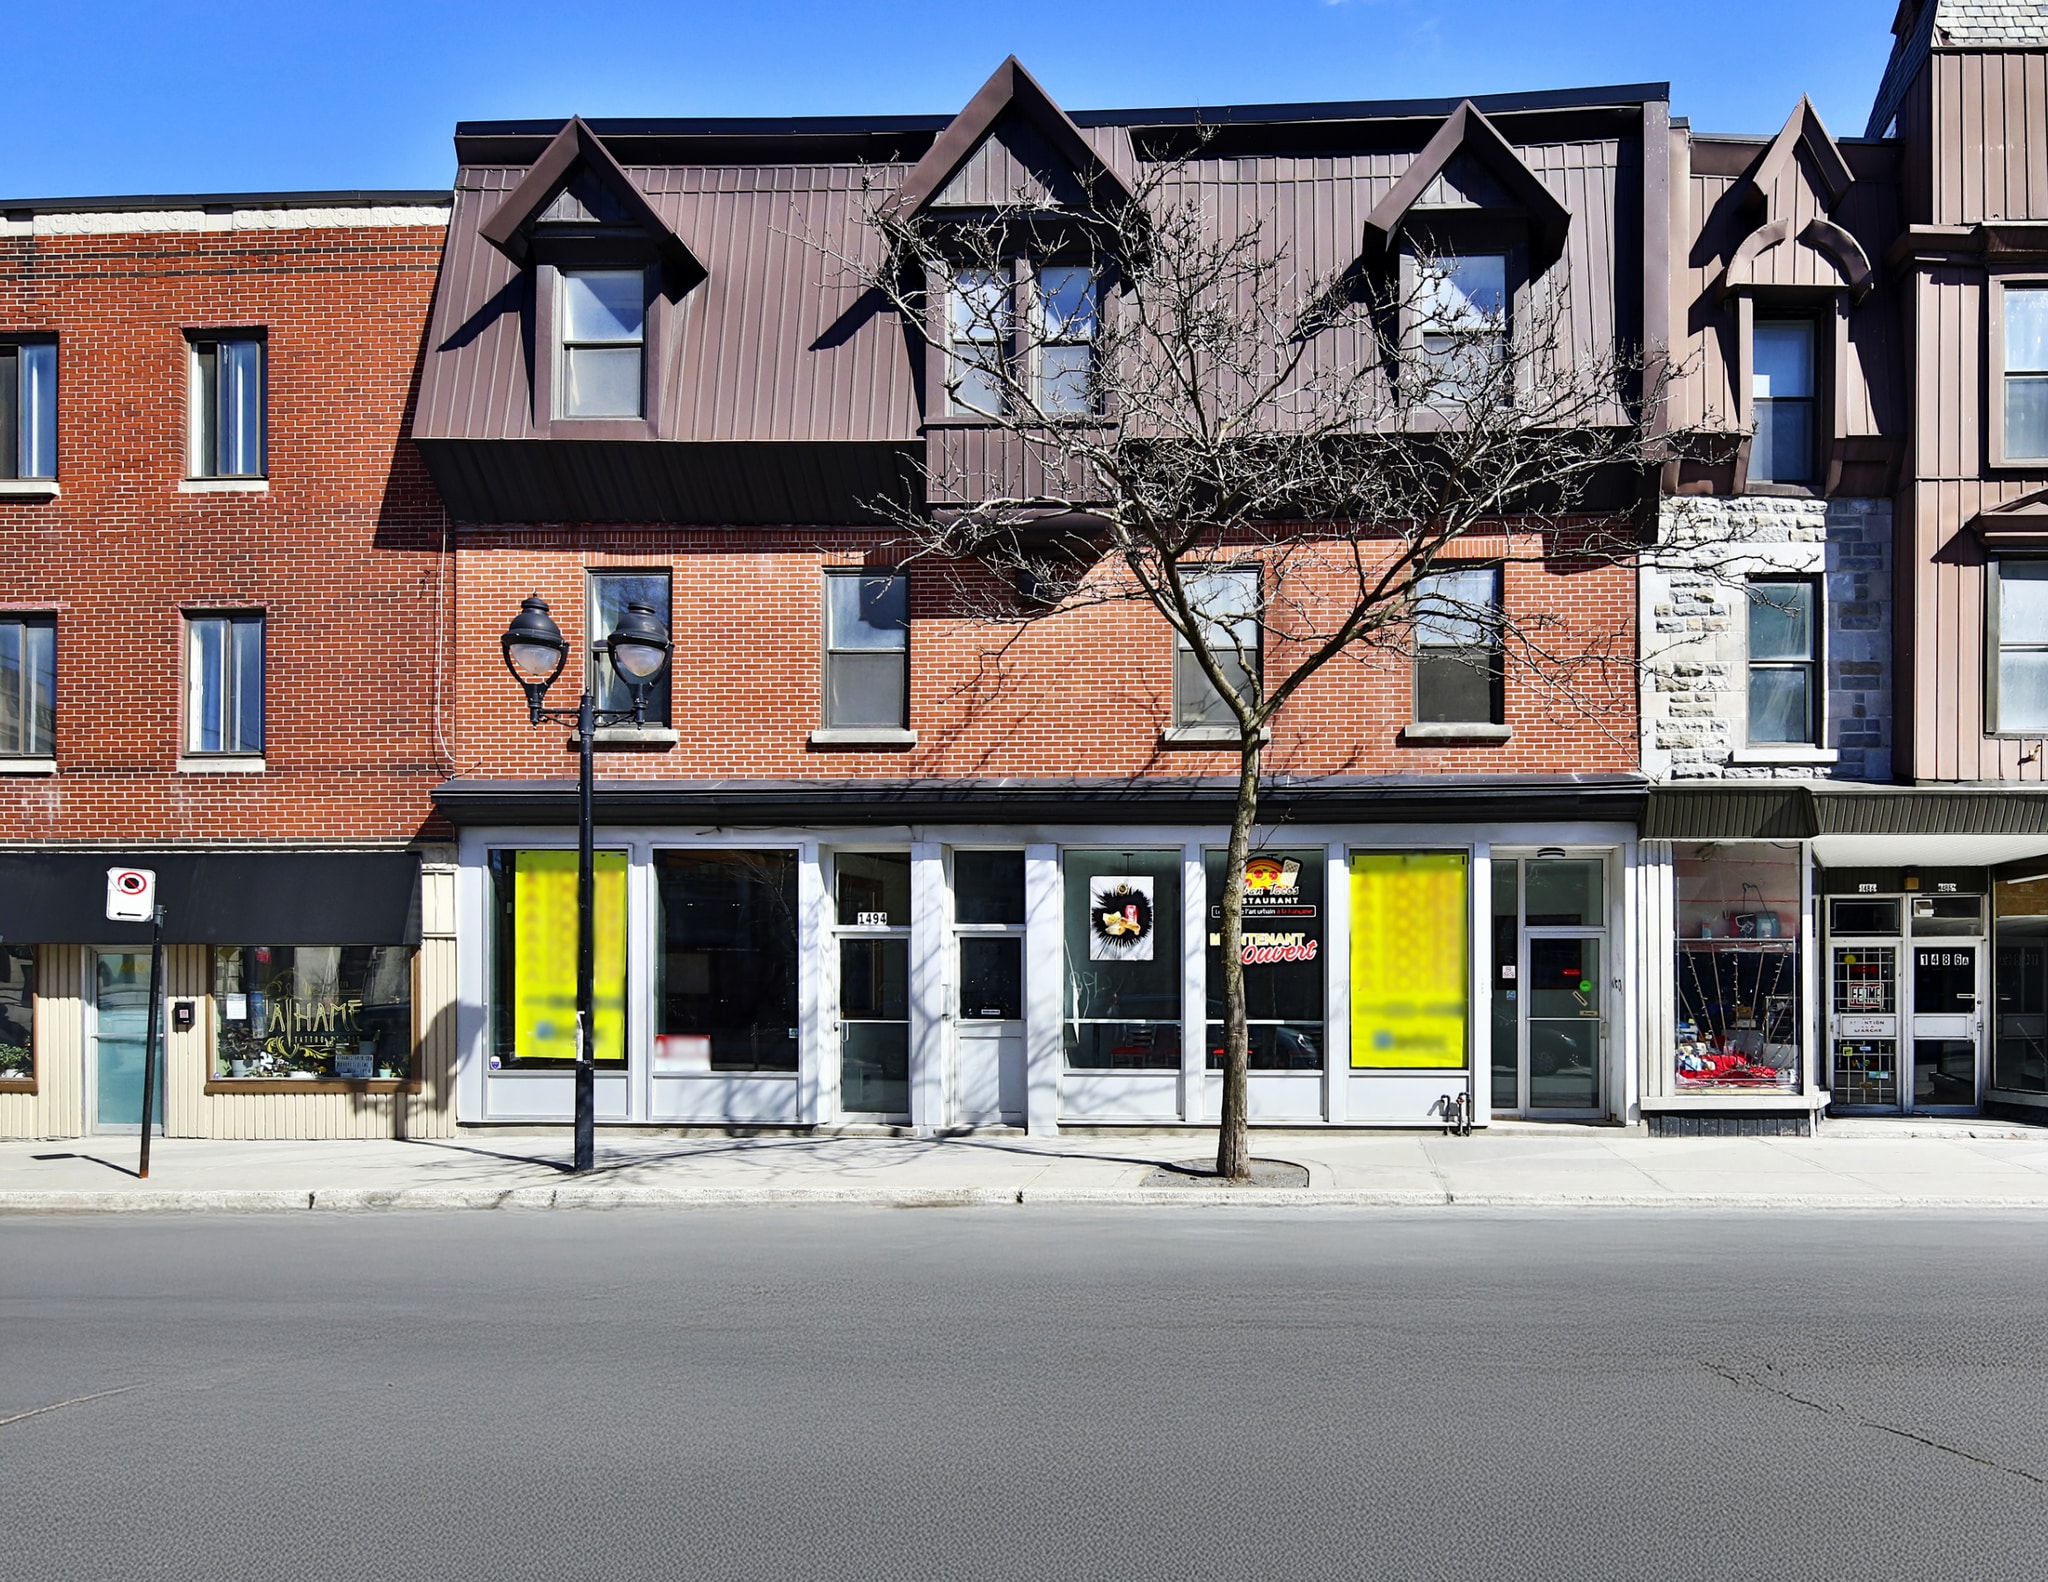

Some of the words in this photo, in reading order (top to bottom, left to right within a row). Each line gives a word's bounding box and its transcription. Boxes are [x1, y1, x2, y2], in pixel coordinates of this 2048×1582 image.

[1243, 884, 1264, 896] ban
[1269, 882, 1300, 896] Tacos
[859, 913, 887, 924] 1494
[1210, 933, 1305, 946] MNTENANT
[1242, 940, 1317, 964] Ouvert
